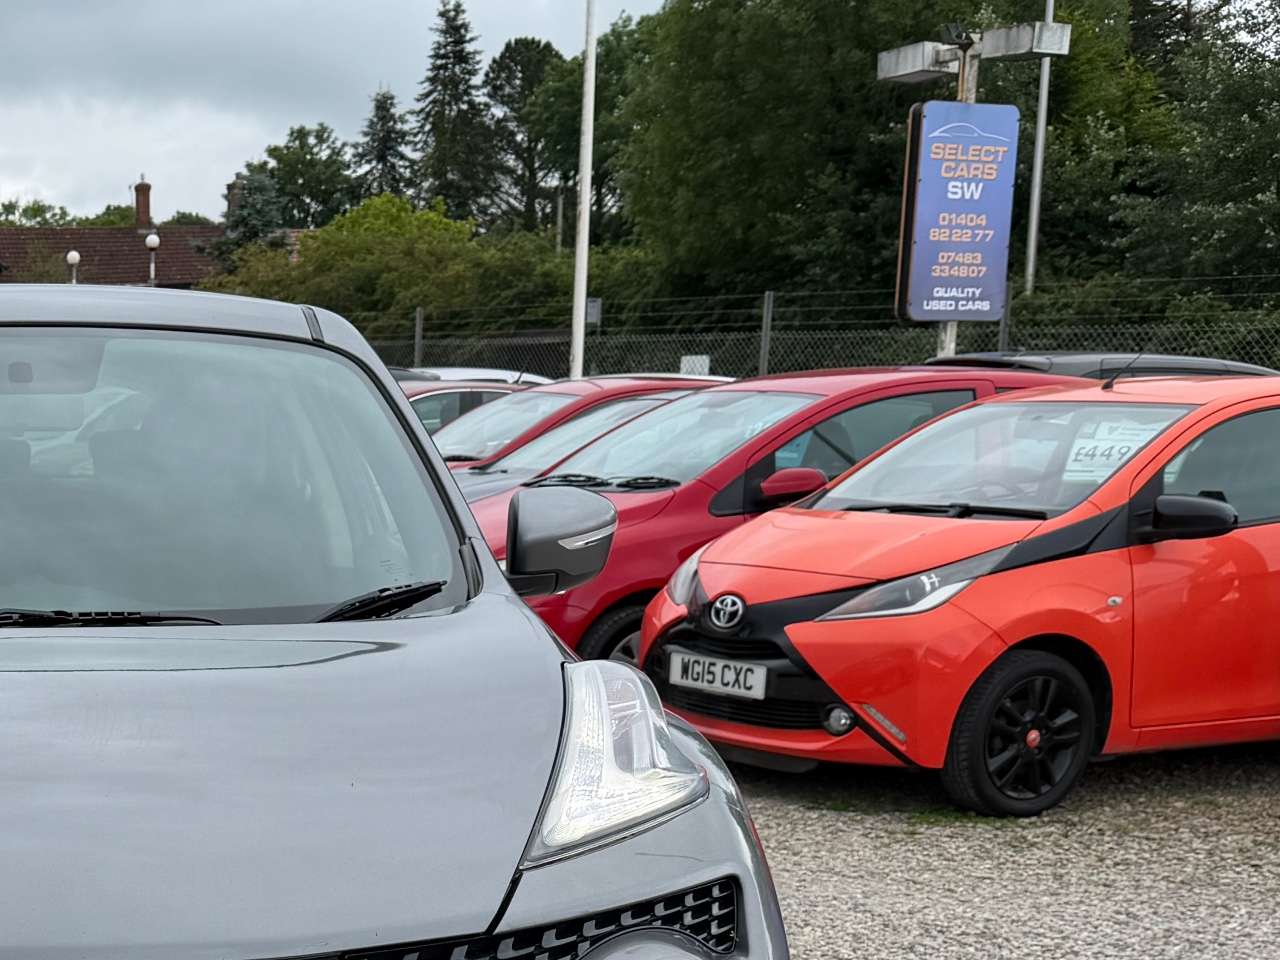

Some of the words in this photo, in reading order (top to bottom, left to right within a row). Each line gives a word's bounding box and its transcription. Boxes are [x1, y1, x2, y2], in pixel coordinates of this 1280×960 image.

[930, 143, 1008, 162] SELECT
[940, 161, 998, 180] CARS
[947, 181, 983, 200] SW
[939, 212, 987, 226] 01404
[938, 251, 982, 264] 07483
[931, 265, 987, 278] 334807
[933, 287, 982, 298] QUALITY
[923, 300, 955, 310] USED
[958, 300, 990, 311] CARS
[680, 657, 717, 684] WG15
[721, 664, 754, 691] CXC
